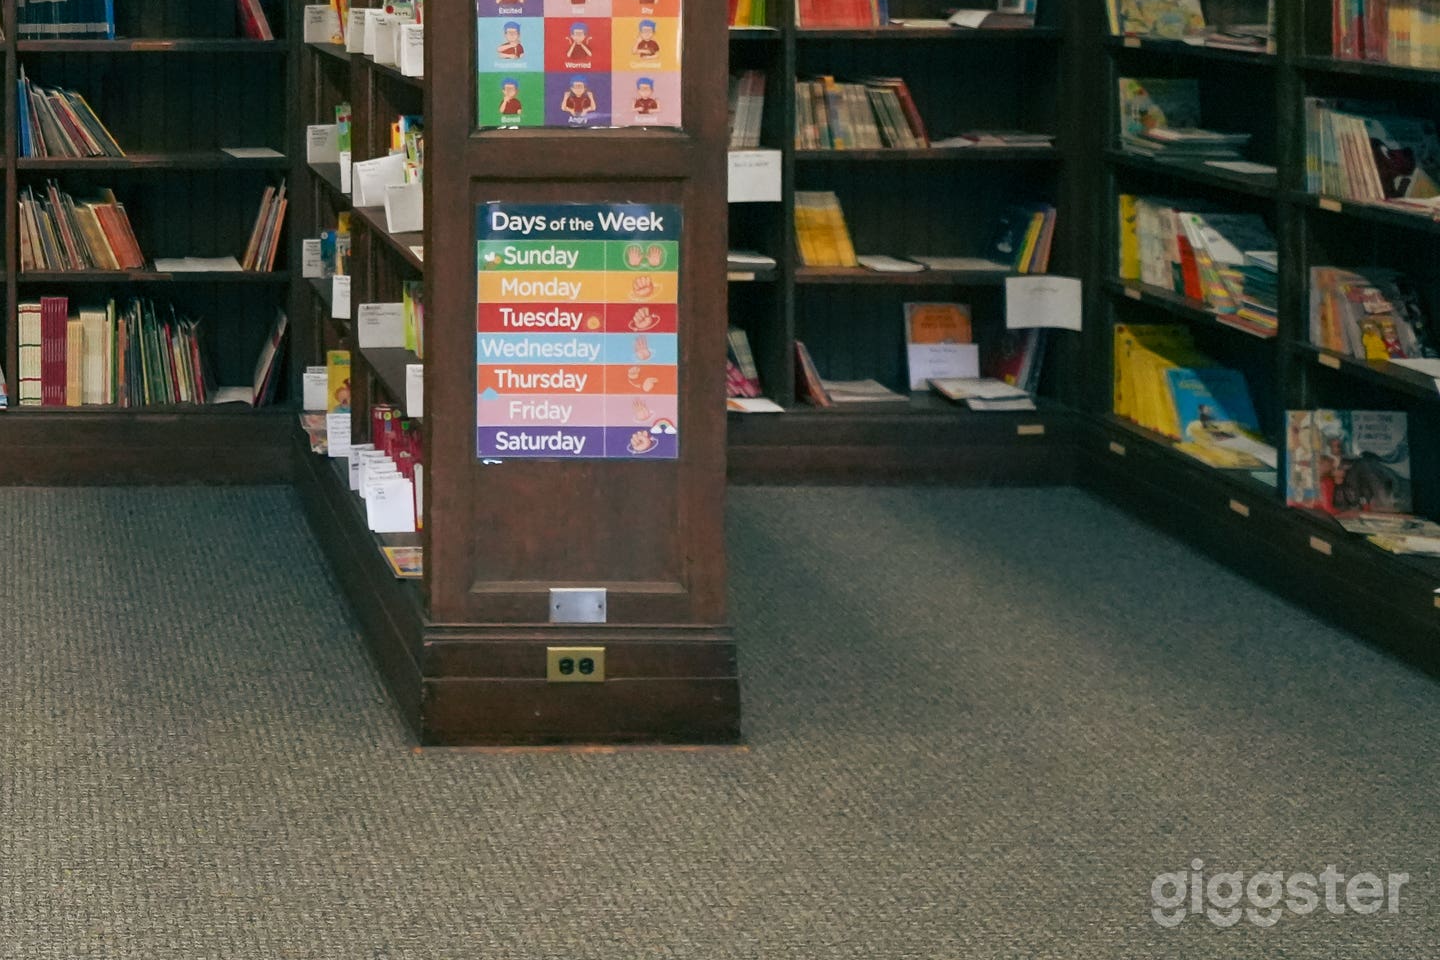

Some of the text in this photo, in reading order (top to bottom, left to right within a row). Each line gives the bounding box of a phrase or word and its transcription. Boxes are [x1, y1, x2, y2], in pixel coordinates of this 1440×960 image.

[498, 7, 522, 15] Excited
[565, 61, 591, 69] Worried
[567, 116, 587, 125] Angry
[492, 212, 663, 234] Days of the Week
[504, 247, 579, 267] Sunday
[501, 278, 581, 299] Monday
[499, 308, 583, 330] Tuesday
[482, 339, 600, 361] Wednesday
[494, 369, 587, 391] Thursday
[508, 401, 572, 423] Friday
[495, 431, 586, 454] Saturday
